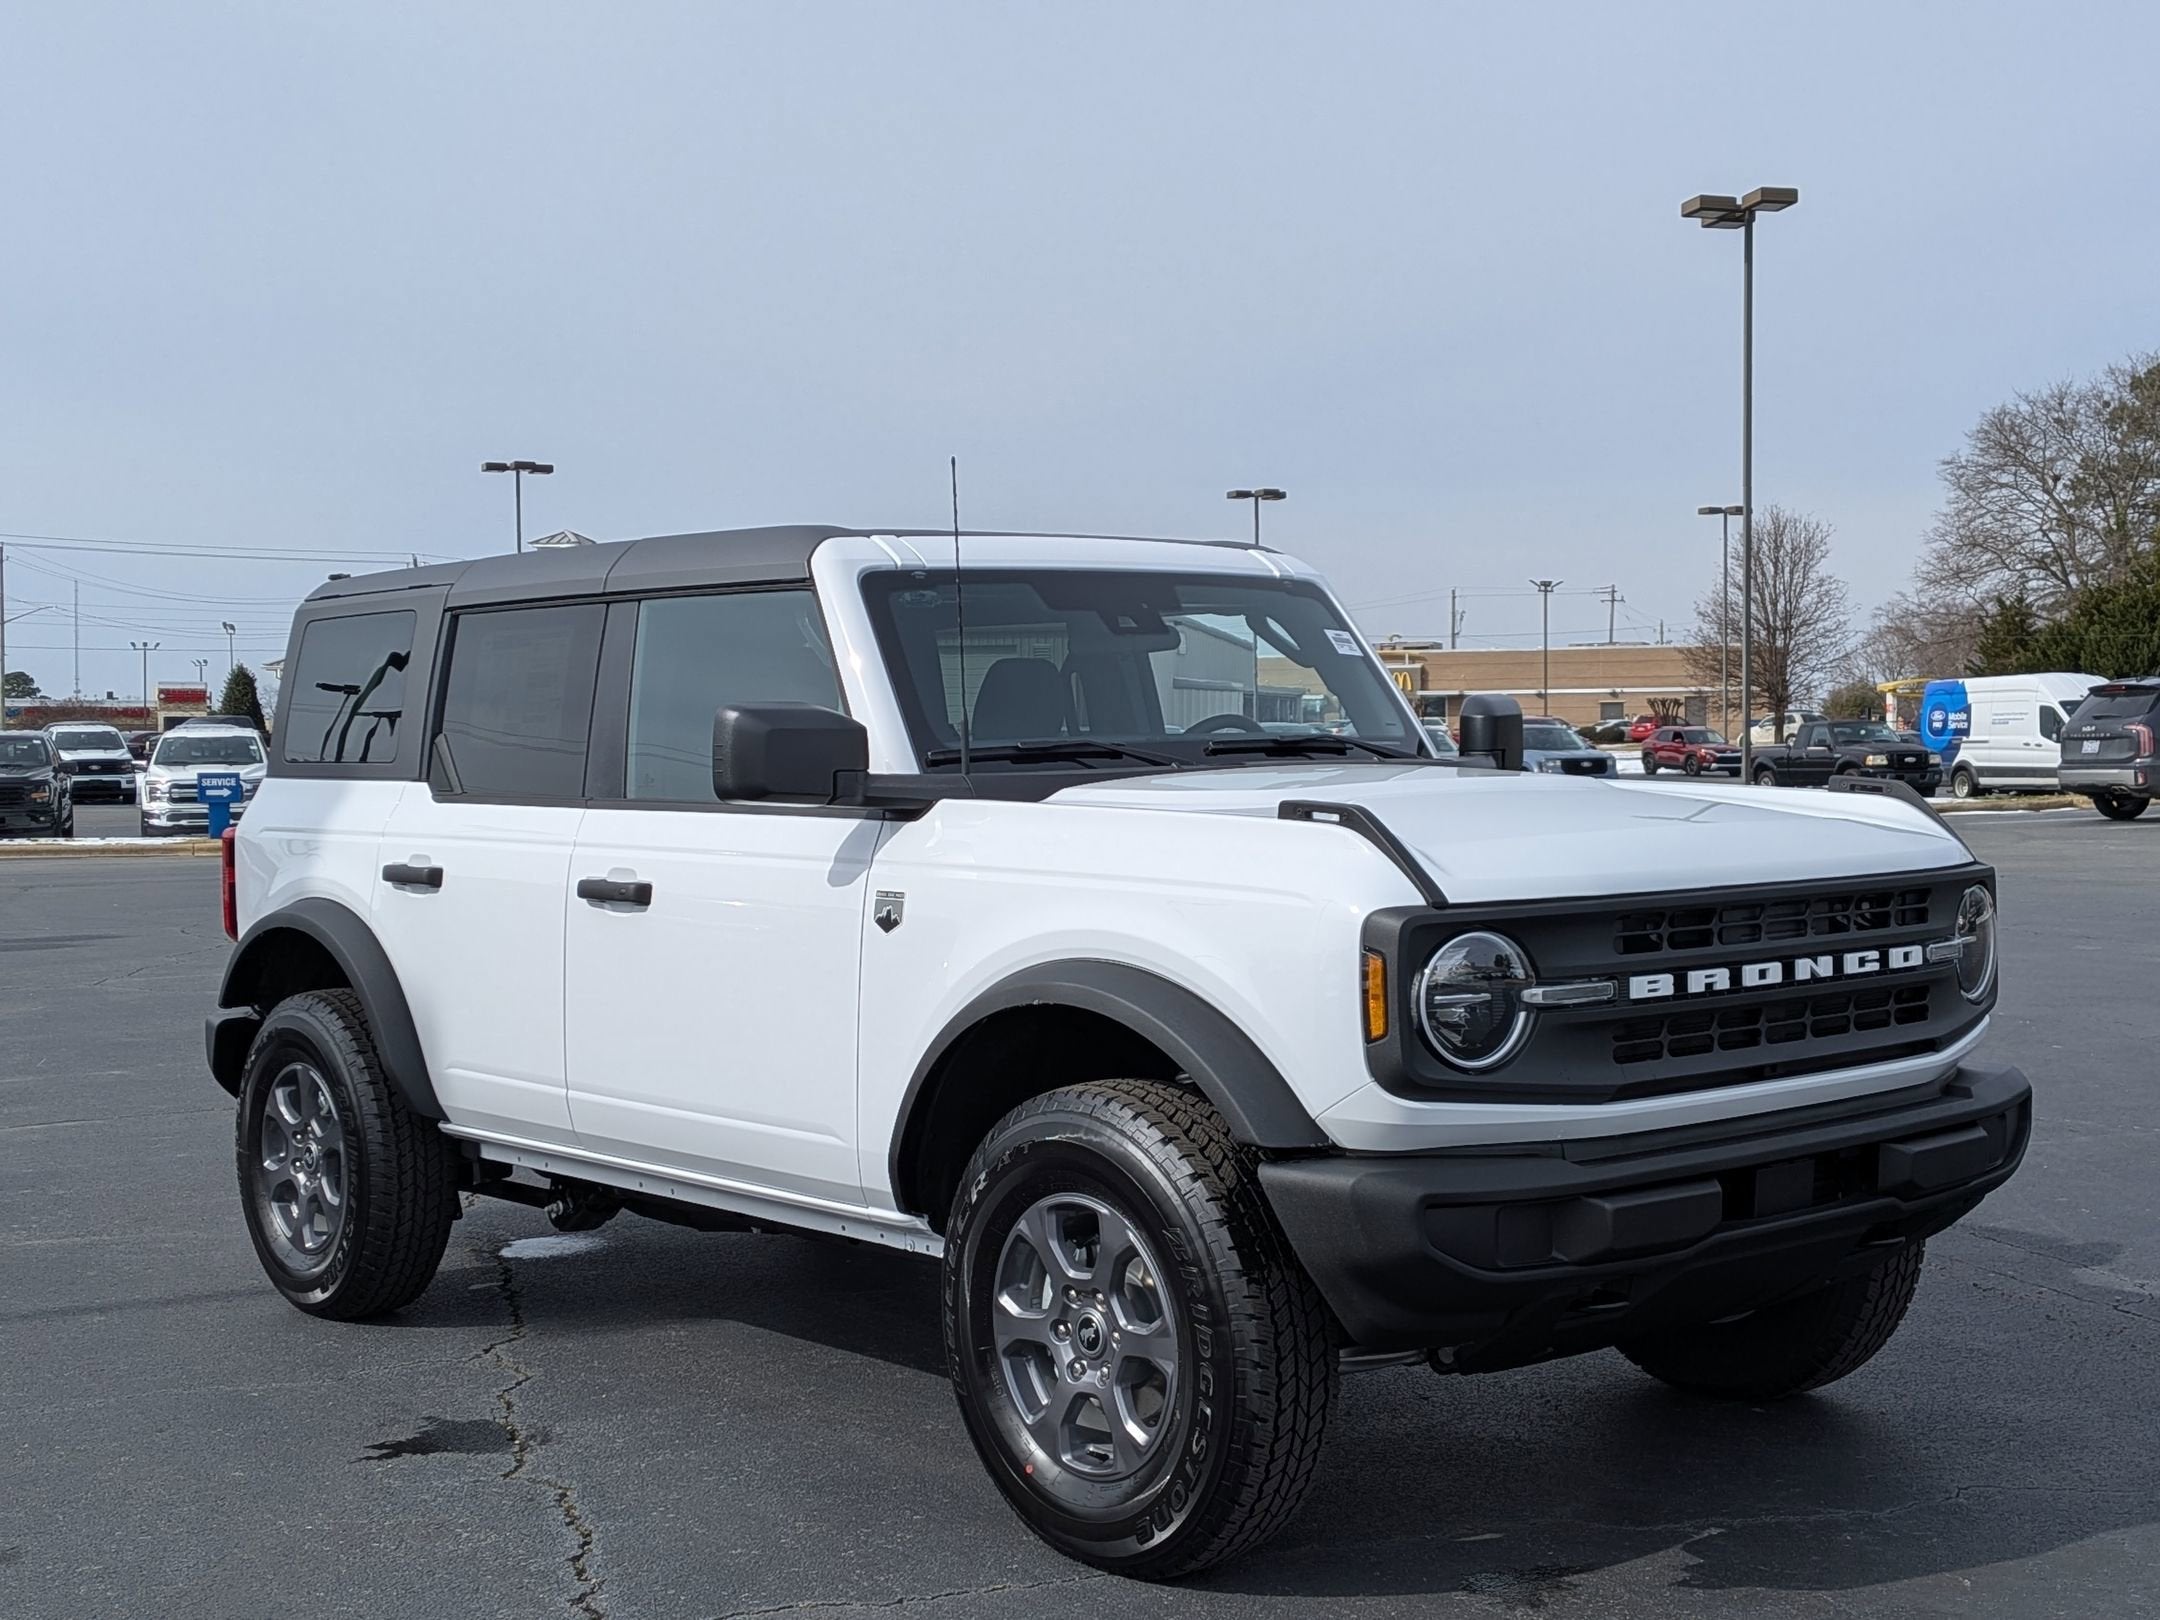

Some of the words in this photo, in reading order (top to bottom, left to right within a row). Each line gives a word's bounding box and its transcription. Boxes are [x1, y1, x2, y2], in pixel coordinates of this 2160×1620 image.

[1948, 712, 1967, 720] Mobile
[1948, 721, 1968, 730] Service
[201, 777, 237, 787] SERVICE
[1629, 945, 1923, 1000] BRONCO
